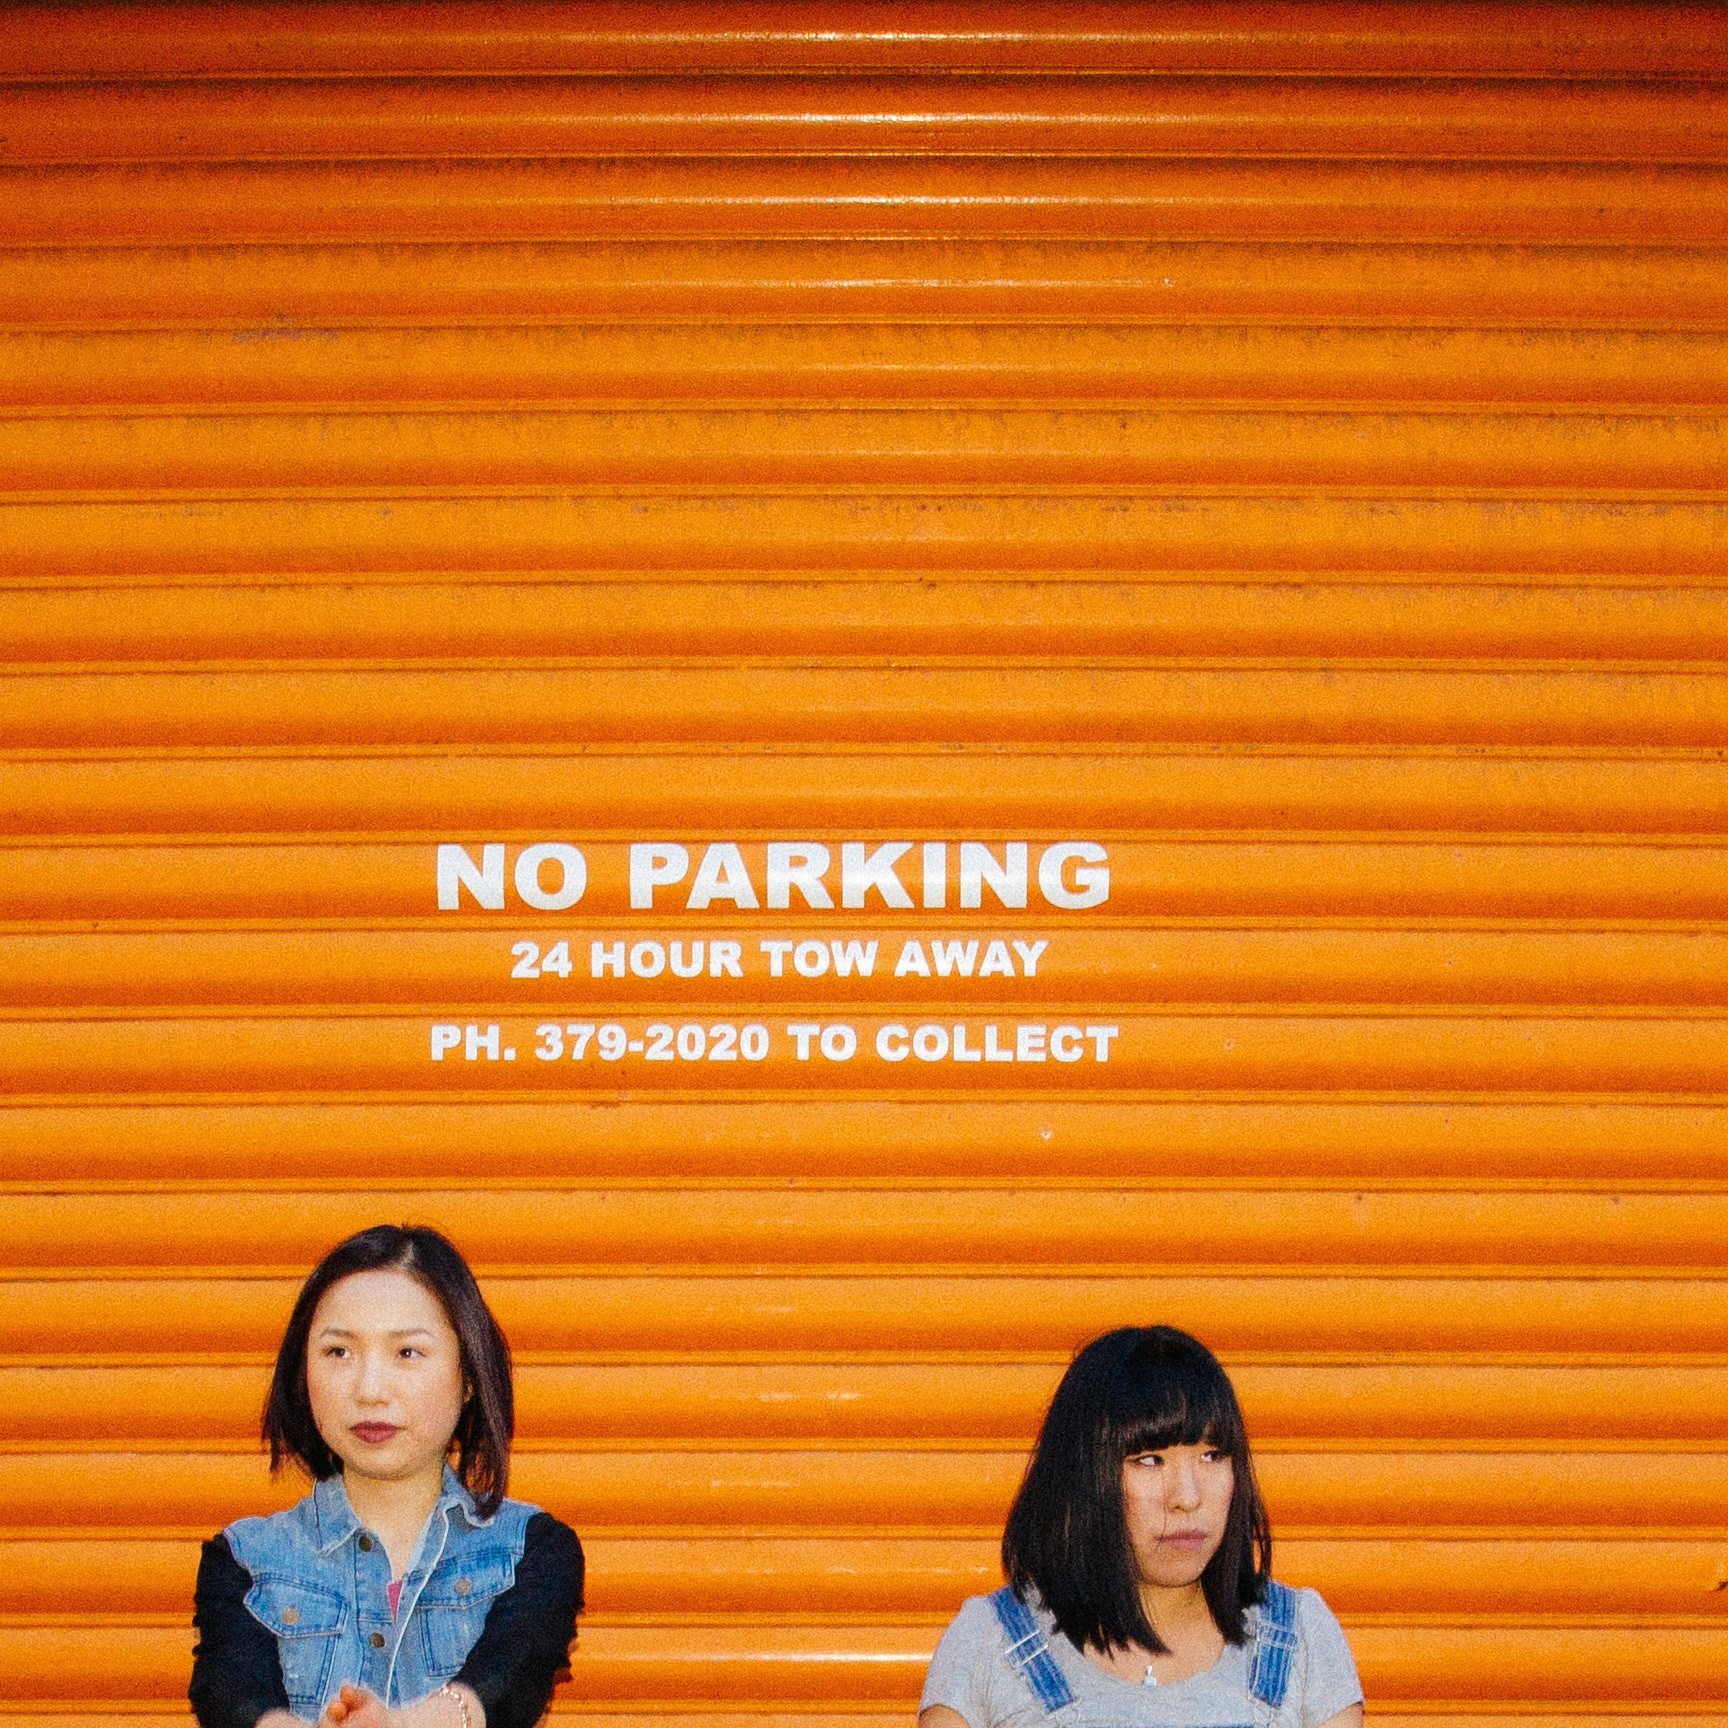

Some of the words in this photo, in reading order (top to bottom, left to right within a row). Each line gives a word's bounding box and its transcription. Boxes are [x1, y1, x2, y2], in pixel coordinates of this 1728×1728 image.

[437, 842, 587, 910] NO
[629, 841, 1111, 909] PARKING
[511, 939, 574, 979] 24
[591, 939, 744, 978] HOUR
[760, 938, 880, 978] TOW
[895, 938, 1049, 978] AWAY
[431, 1023, 517, 1061] PH.
[535, 1022, 771, 1061] 379-2020
[786, 1022, 858, 1062] TO
[876, 1022, 1120, 1063] COLLECT
